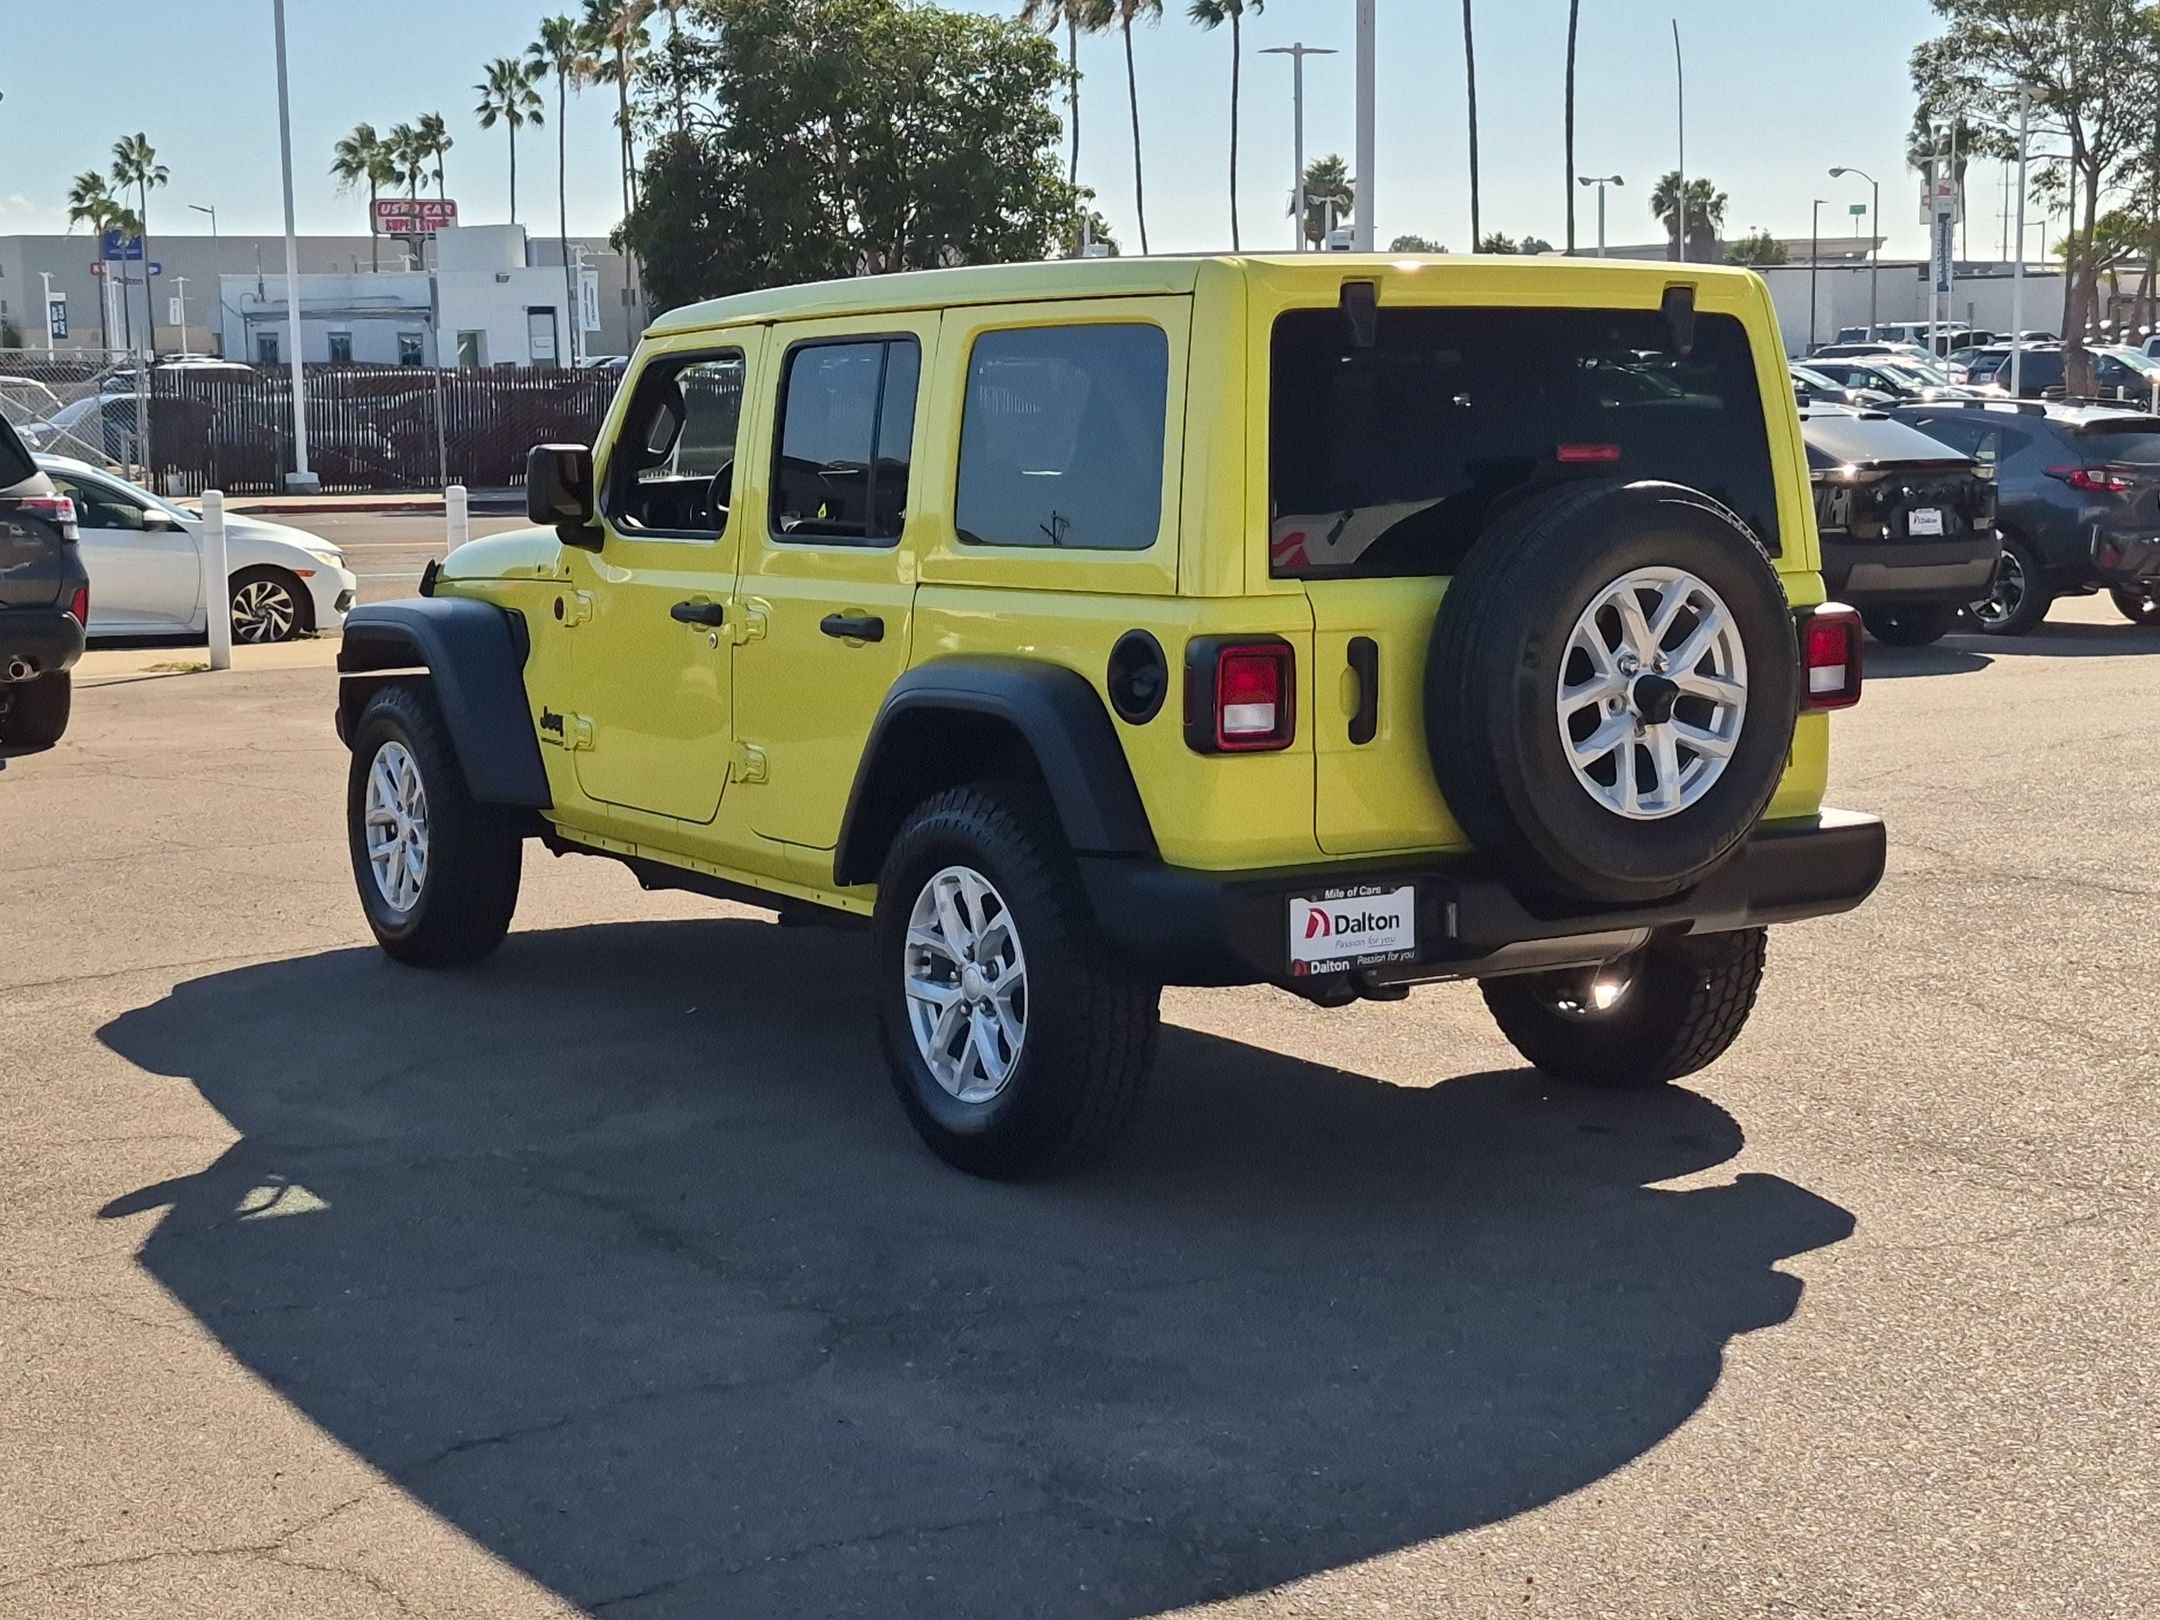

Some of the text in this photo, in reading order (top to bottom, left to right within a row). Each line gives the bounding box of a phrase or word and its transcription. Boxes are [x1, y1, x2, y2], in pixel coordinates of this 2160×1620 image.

[381, 204, 452, 215] USED CAR
[540, 705, 563, 737] Jeep
[1325, 886, 1381, 899] Mile of Cars
[1334, 912, 1400, 936] Dalton
[1336, 935, 1397, 949] Passion for you
[1357, 951, 1415, 965] Passion for you
[1311, 959, 1350, 974] Dalton
